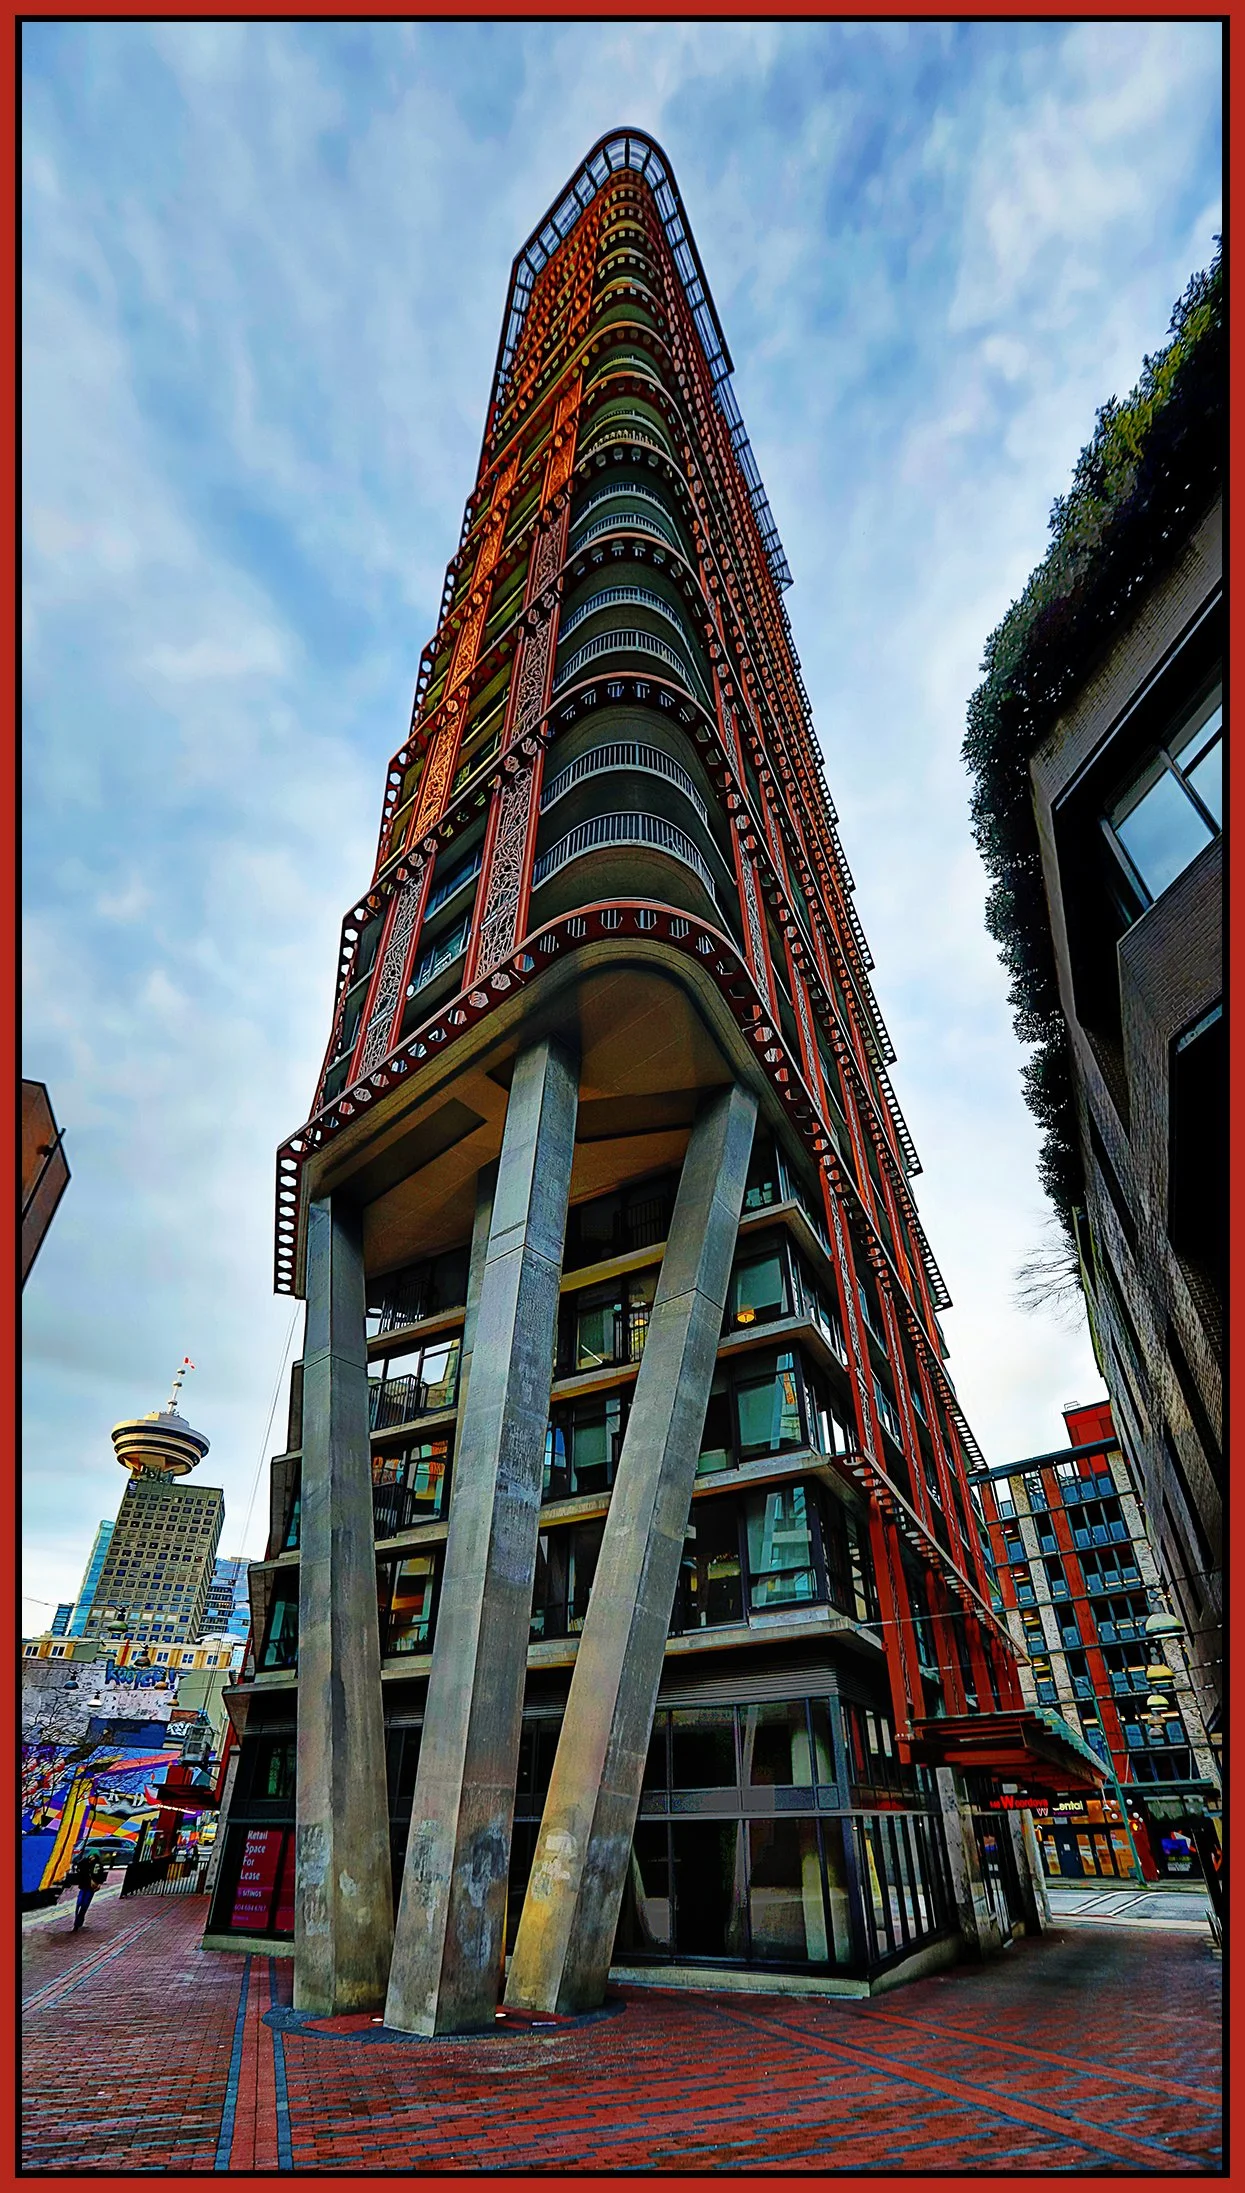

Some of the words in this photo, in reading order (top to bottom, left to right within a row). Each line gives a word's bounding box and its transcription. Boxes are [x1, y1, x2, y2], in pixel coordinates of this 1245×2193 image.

[1053, 1800, 1084, 1811] ental
[247, 1830, 268, 1840] Retail
[245, 1842, 266, 1855] Space
[243, 1856, 255, 1866] For
[240, 1869, 260, 1880] Lease
